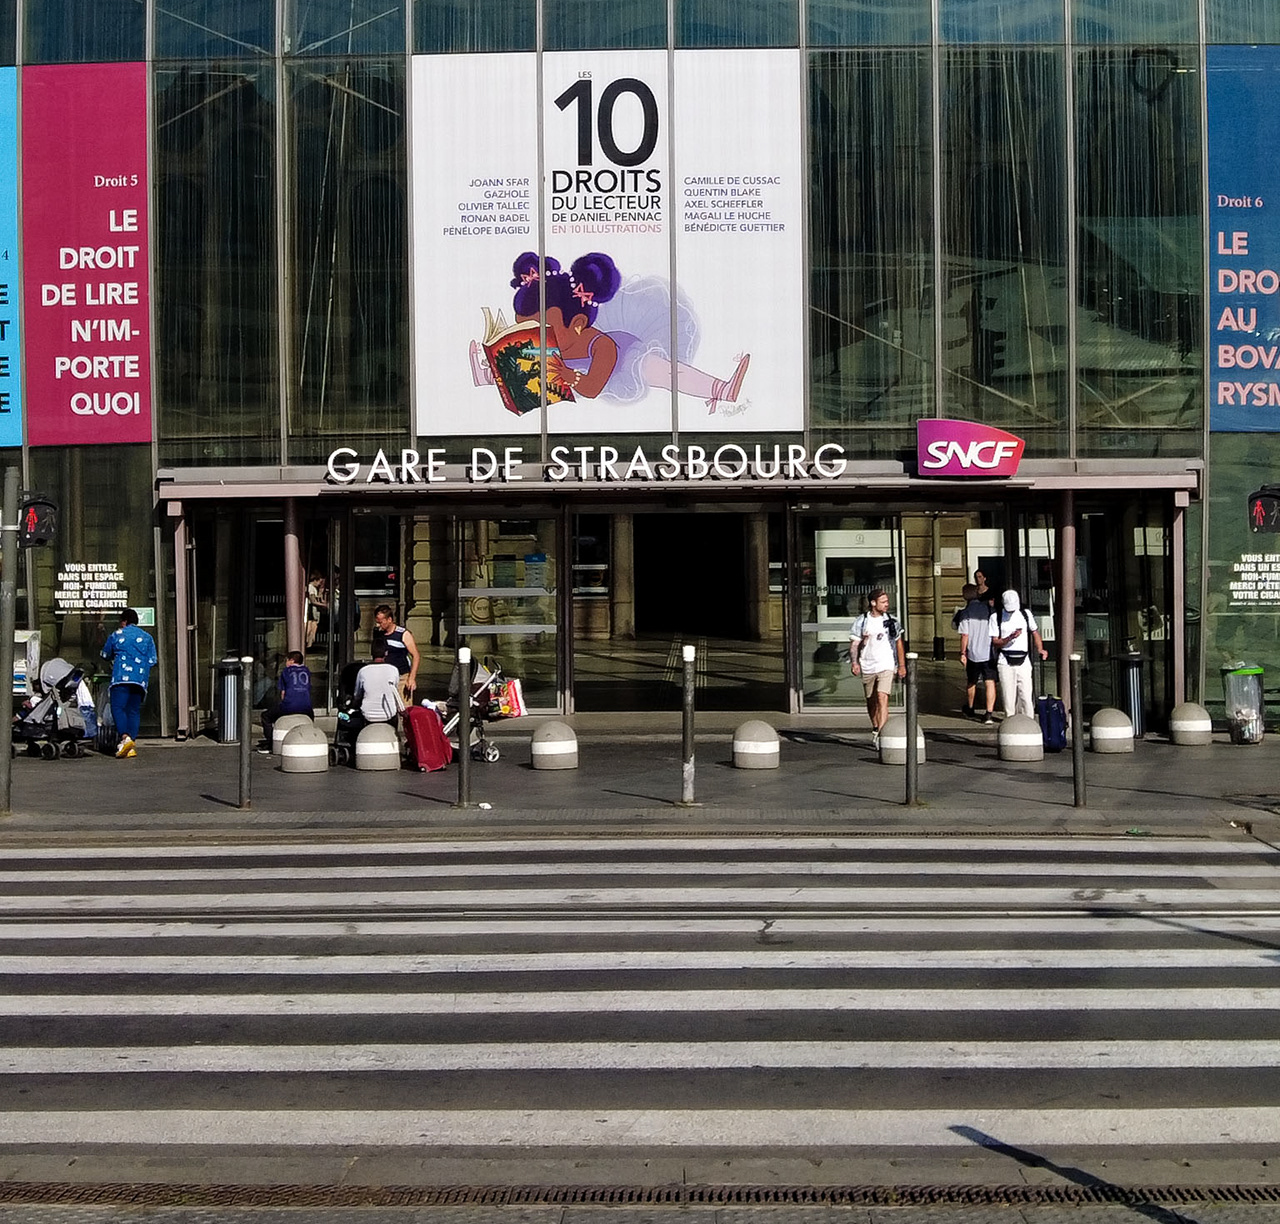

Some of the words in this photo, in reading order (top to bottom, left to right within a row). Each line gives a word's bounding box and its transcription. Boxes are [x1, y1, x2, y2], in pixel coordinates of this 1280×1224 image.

[554, 78, 659, 167] 10
[94, 175, 127, 188] Droit
[130, 175, 138, 187] 5
[469, 179, 503, 187] JOANN
[506, 178, 529, 186] SFAR
[552, 169, 661, 193] DROITS
[684, 177, 724, 185] CAMILLE
[727, 177, 740, 185] DE
[742, 176, 780, 185] CUSSAC
[484, 190, 529, 198] GAZHOLE
[684, 188, 728, 197] QUENTIN
[731, 188, 761, 196] BLAKE
[458, 202, 494, 211] OLIVIER
[496, 202, 530, 210] TALLEC
[552, 196, 577, 210] DU
[584, 196, 661, 209] LECTEUR
[684, 200, 708, 208] AXEL
[711, 200, 763, 208] SCHEFFLER
[1217, 195, 1252, 208] Droit
[1255, 196, 1263, 207] 6
[109, 209, 138, 232] LE
[461, 214, 496, 223] RONAN
[499, 214, 530, 222] BADEL
[552, 213, 567, 222] DE
[571, 213, 611, 222] DANIEL
[615, 212, 661, 221] PENNAC
[684, 212, 722, 220] MAGALI
[724, 212, 735, 220] LE
[738, 212, 771, 220] HUCHE
[443, 225, 492, 235] PÉNÉLOPE
[494, 226, 530, 234] BAGIEU
[552, 225, 566, 234] EN
[570, 225, 580, 233] 10
[583, 224, 662, 233] ILLUSTRATIONS
[684, 222, 737, 232] BÉNÉDICTE
[740, 223, 785, 232] GUETTIER
[1217, 231, 1249, 255] LE
[2, 249, 9, 262] 4
[59, 246, 139, 270] DROIT
[41, 284, 75, 306] DE
[86, 283, 139, 305] LIRE
[1217, 307, 1257, 332] AU
[55, 356, 140, 379] PORTE
[70, 392, 140, 415] QUOI
[923, 441, 1018, 468] SNCF
[327, 447, 447, 482] GARE
[472, 447, 524, 481] DE
[550, 443, 847, 480] STRASBOURG
[65, 563, 86, 572] VOUS
[87, 563, 118, 571] ENTREZ
[58, 573, 79, 581] DANS
[81, 573, 92, 581] UN
[94, 573, 124, 581] ESPACE
[85, 582, 117, 590] FUMEUR
[55, 591, 80, 599] MERCI
[59, 600, 84, 608] VOTRE
[86, 600, 127, 608] CIGARETTE
[290, 671, 309, 685] 10
